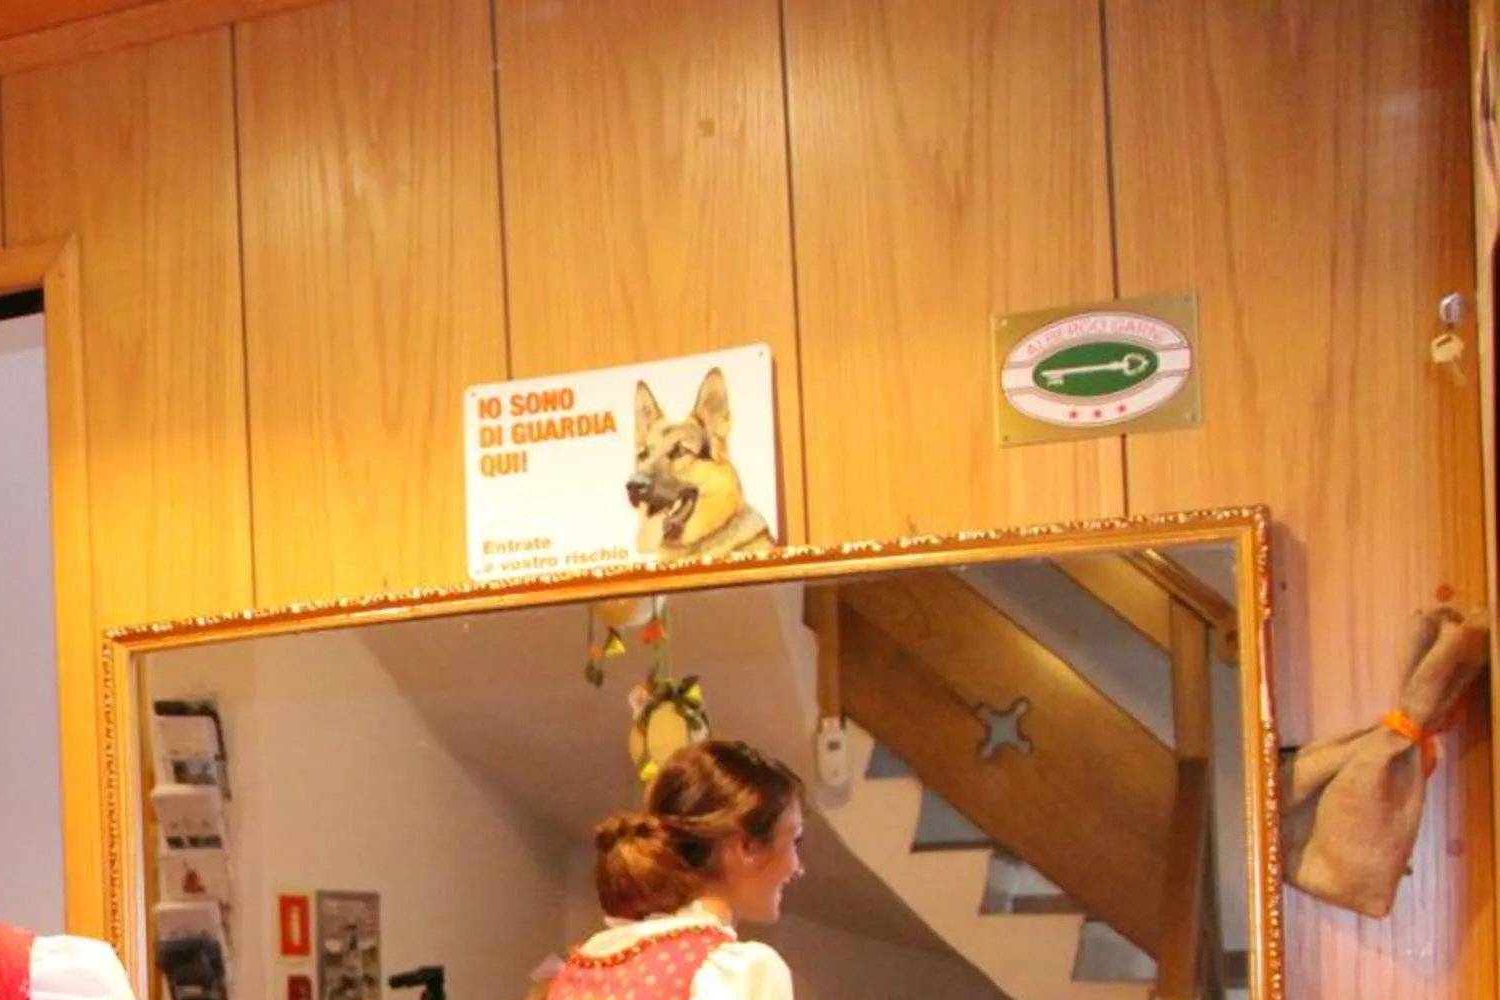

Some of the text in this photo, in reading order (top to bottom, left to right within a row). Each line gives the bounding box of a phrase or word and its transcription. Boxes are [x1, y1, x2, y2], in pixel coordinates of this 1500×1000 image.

[478, 387, 575, 420] IO SONO
[479, 410, 618, 449] DI GUARDIA
[480, 451, 529, 478] QUI!
[483, 536, 553, 556] Entrate
[500, 551, 559, 573] vostro
[565, 544, 630, 567] rischio
